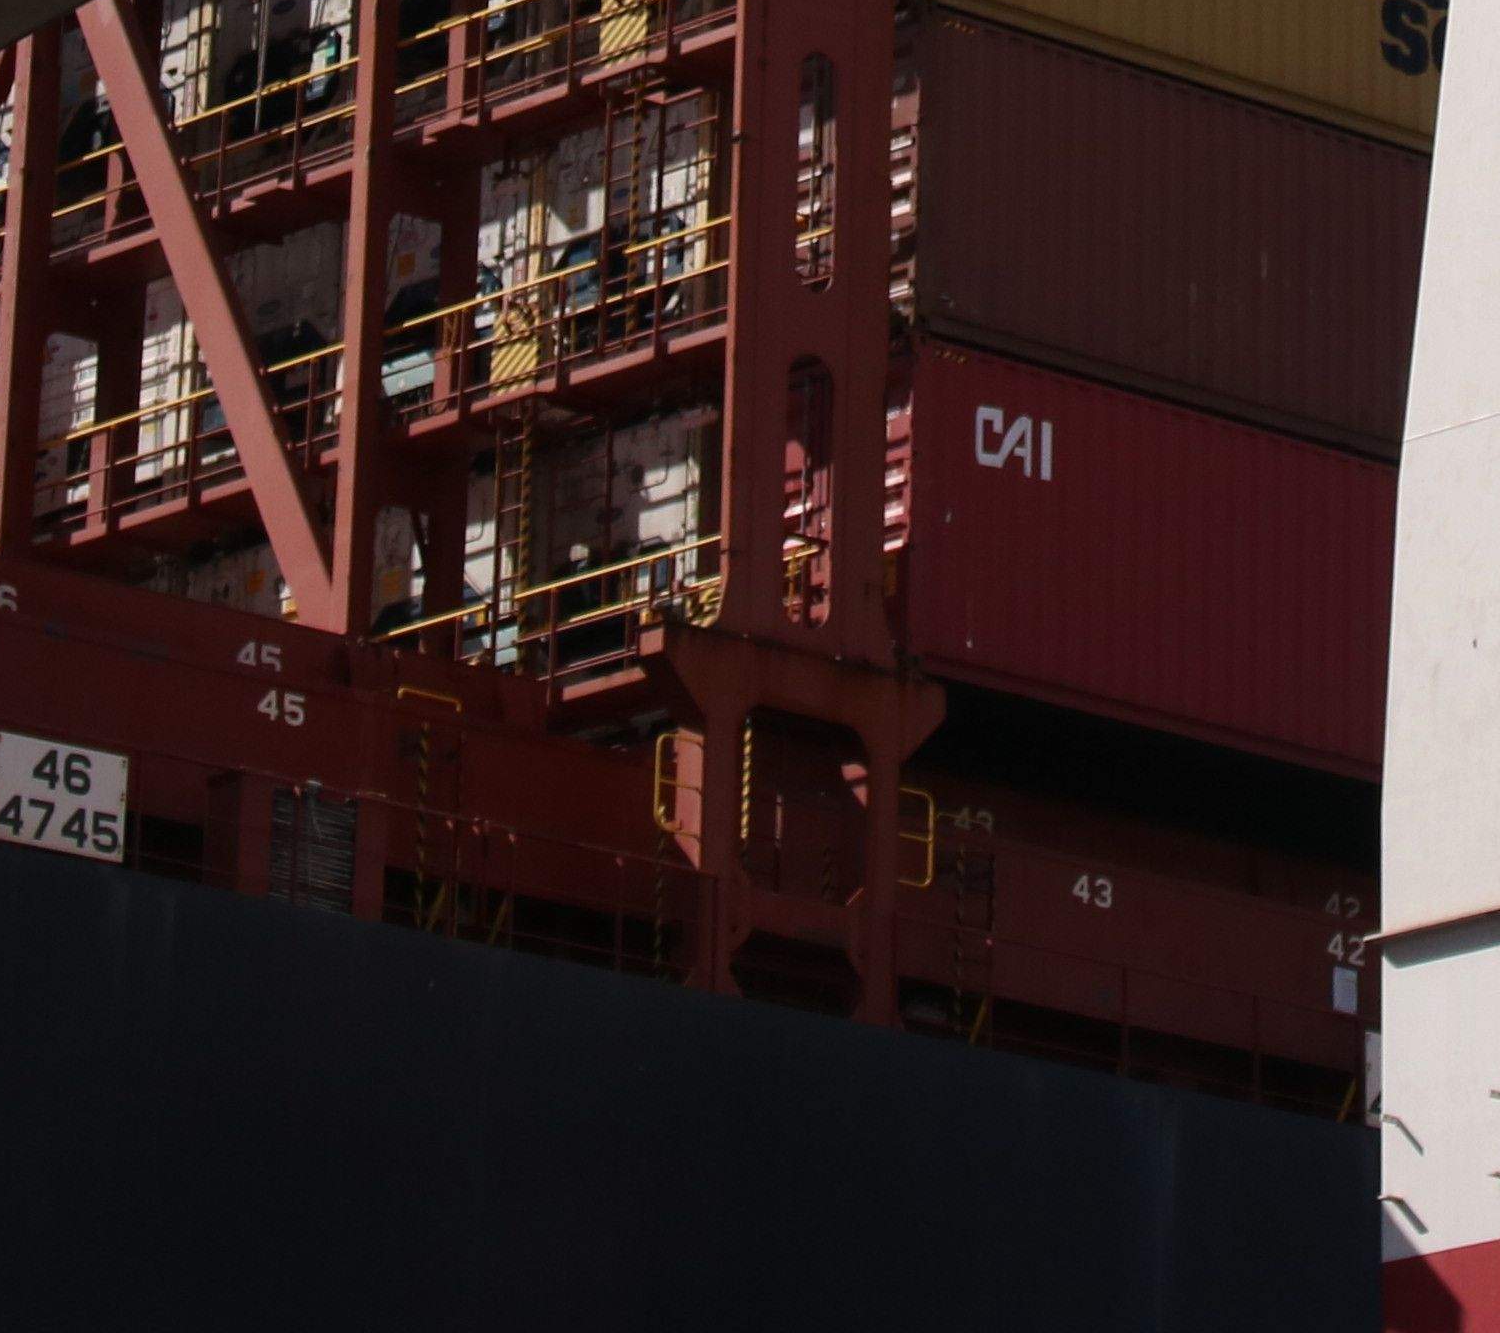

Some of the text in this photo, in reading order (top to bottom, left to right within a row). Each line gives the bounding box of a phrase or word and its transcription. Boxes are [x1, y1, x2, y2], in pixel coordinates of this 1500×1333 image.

[974, 405, 1054, 483] CAI
[234, 639, 285, 674] 45
[256, 688, 308, 727] 45
[32, 749, 93, 797] 46
[1071, 873, 1115, 910] 43
[1326, 931, 1367, 967] 42
